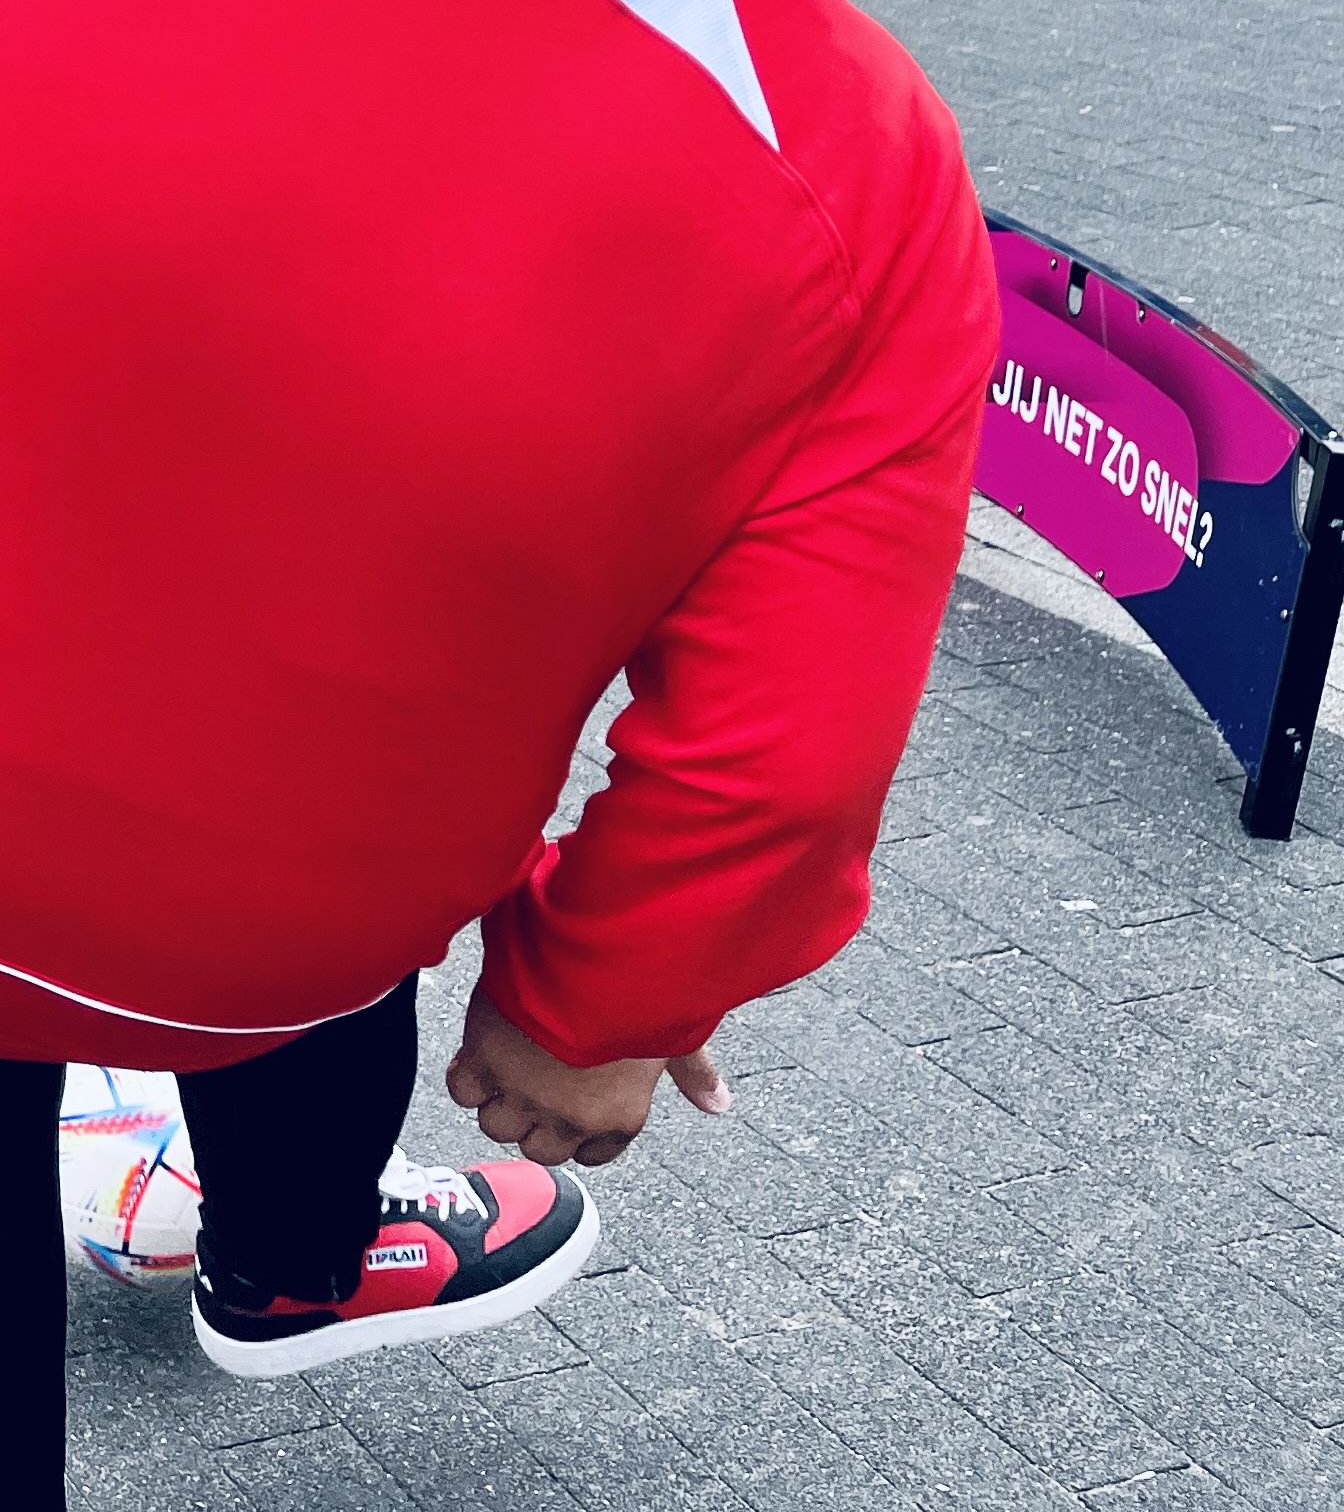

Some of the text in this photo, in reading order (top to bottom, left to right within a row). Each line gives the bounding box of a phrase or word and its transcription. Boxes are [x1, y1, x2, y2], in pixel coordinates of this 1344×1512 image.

[992, 359, 1214, 569] JIJ NET ZO SNEL?
